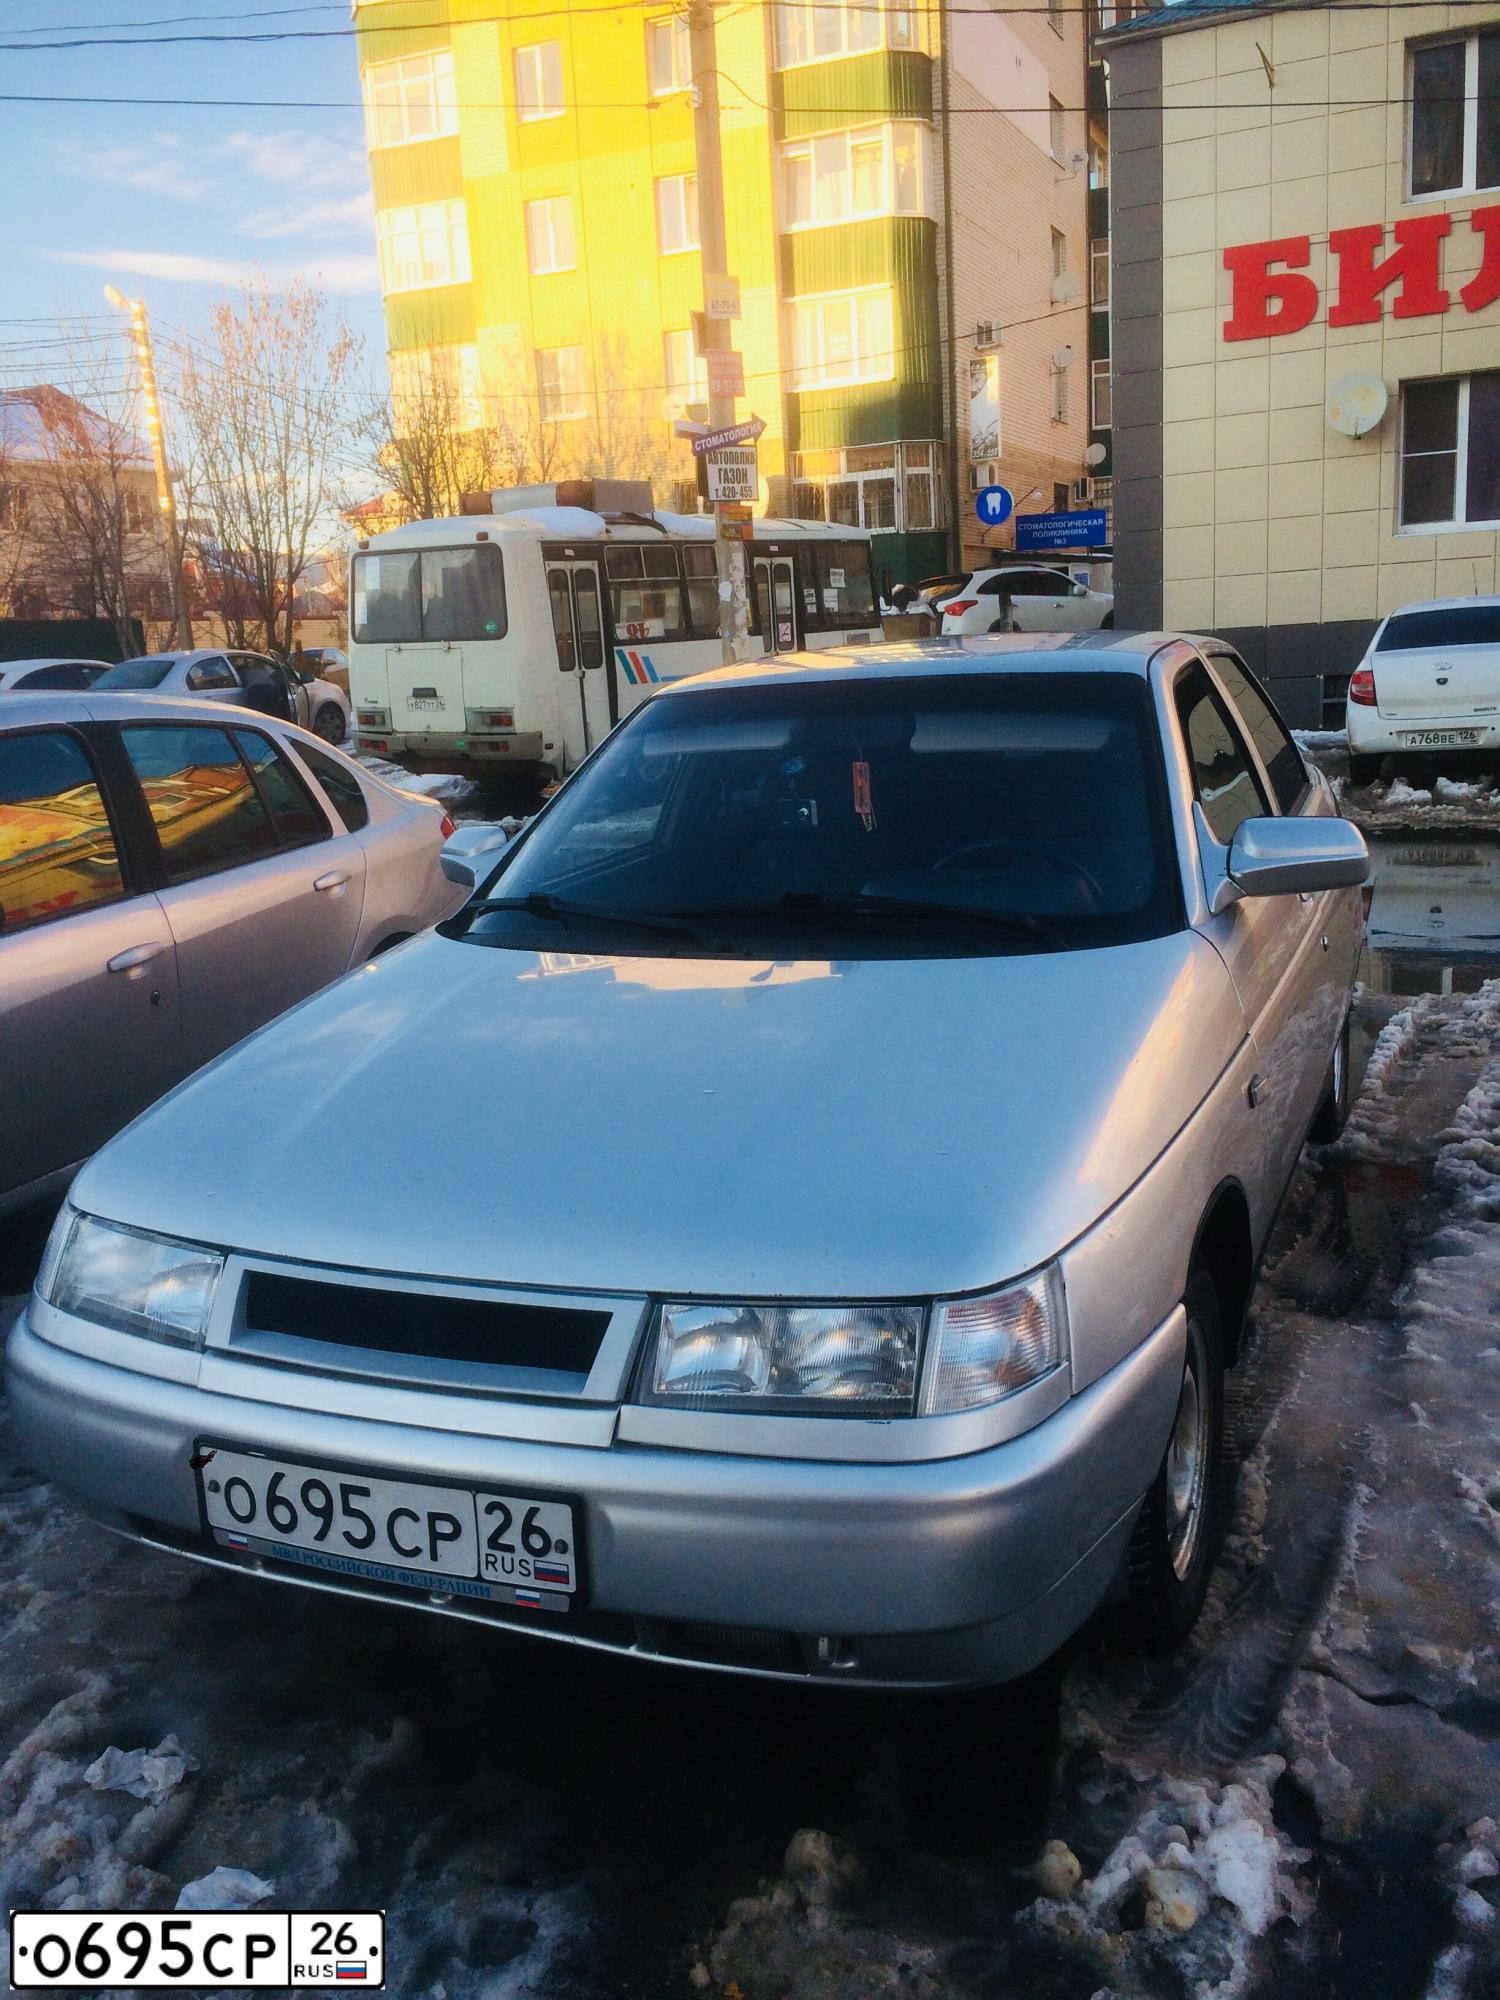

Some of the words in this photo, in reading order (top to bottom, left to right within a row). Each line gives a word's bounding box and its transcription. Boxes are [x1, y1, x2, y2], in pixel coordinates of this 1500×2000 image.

[695, 422, 762, 452] СТОМАТОЛОГИЯ
[718, 467, 748, 485] ГАЗОН
[1018, 518, 1104, 531] СТОМАТОЛОГИЧЕСКАЯ
[1032, 528, 1088, 539] ПОЛИКЛИНИКА
[1410, 732, 1455, 745] А768ВЕ
[1459, 730, 1476, 740] 126
[224, 1472, 462, 1562] О695СР
[485, 1501, 552, 1558] 26
[303, 1551, 394, 1581] РОССИЙСКОЙ
[398, 1573, 492, 1599] ФЕДЕРАЦИИ
[485, 1553, 532, 1577] RUS
